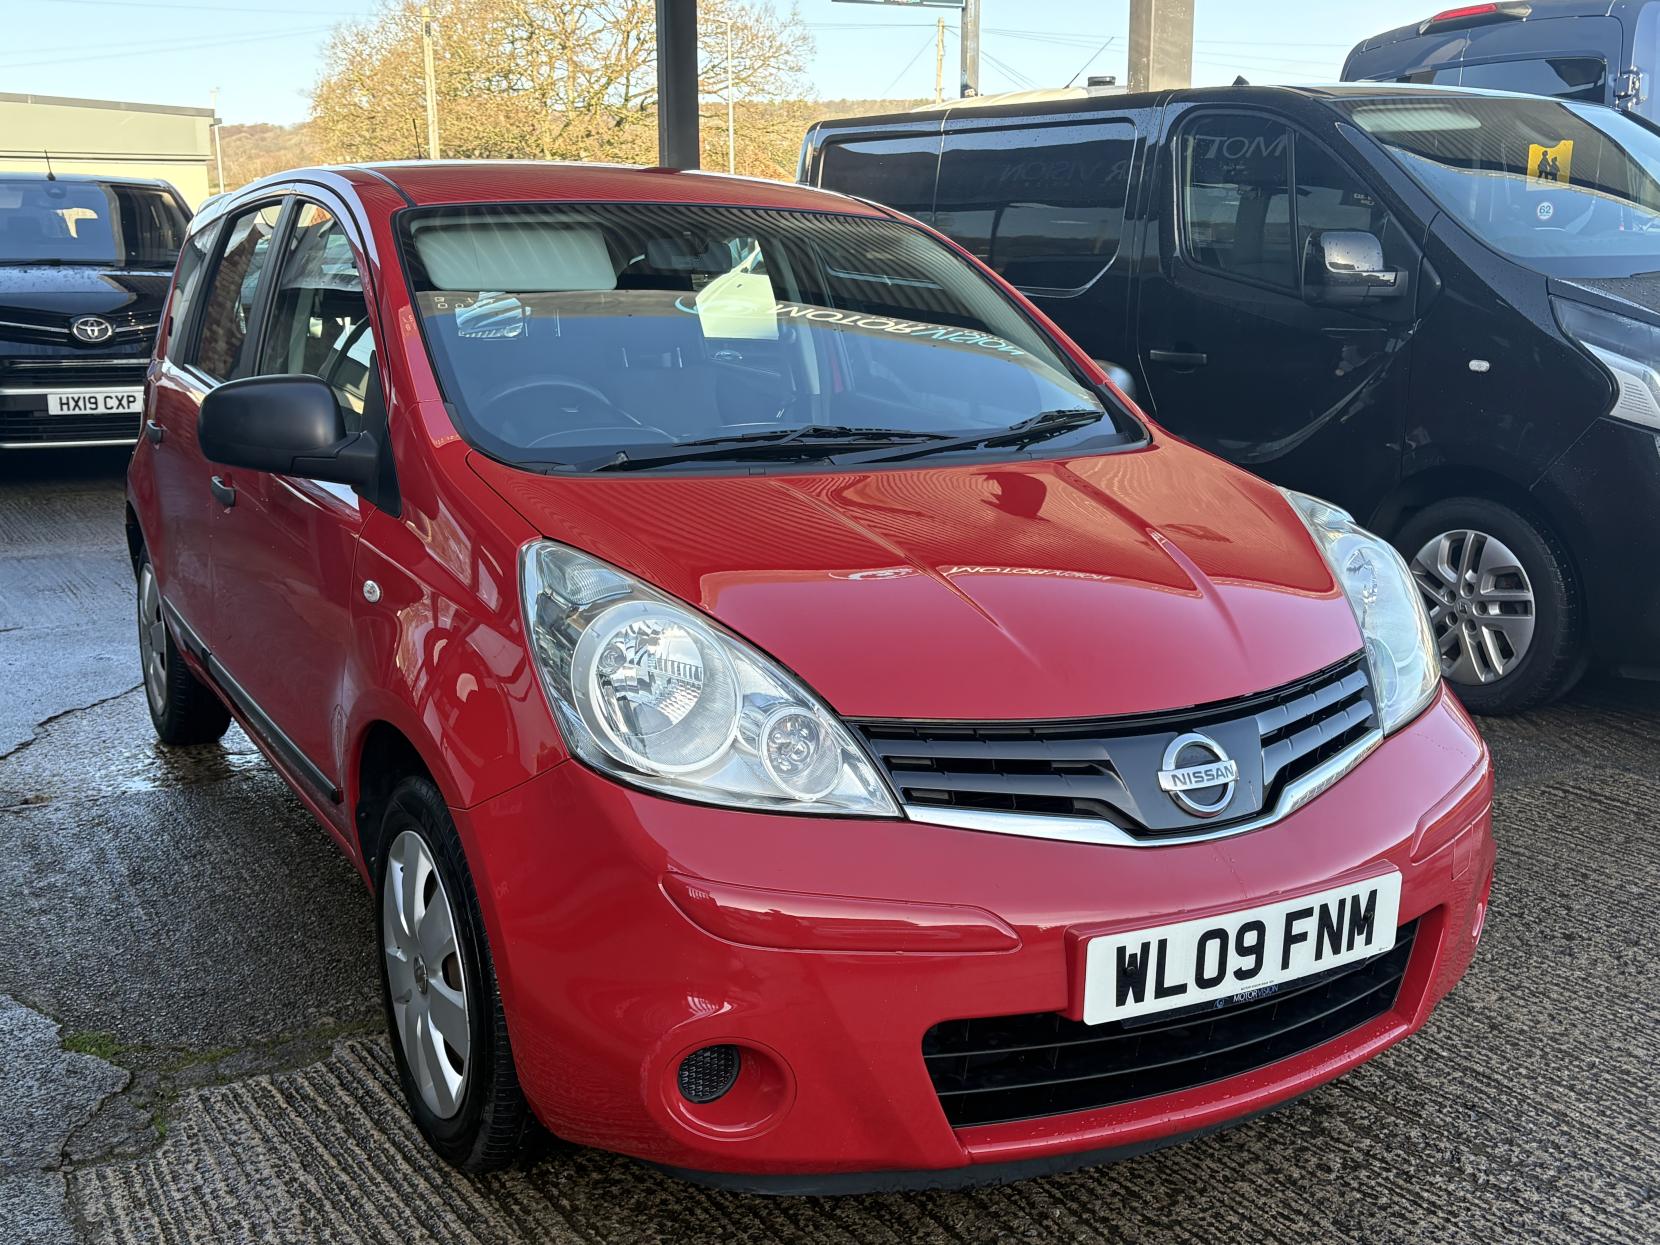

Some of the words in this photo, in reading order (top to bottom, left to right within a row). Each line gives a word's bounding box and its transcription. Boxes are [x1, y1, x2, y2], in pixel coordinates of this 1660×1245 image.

[1539, 204, 1552, 214] 62
[59, 396, 98, 411] HX19
[104, 395, 136, 410] CXP
[1171, 764, 1234, 787] NISSAN
[1115, 919, 1267, 1007] WL09
[1281, 888, 1378, 971] FNM
